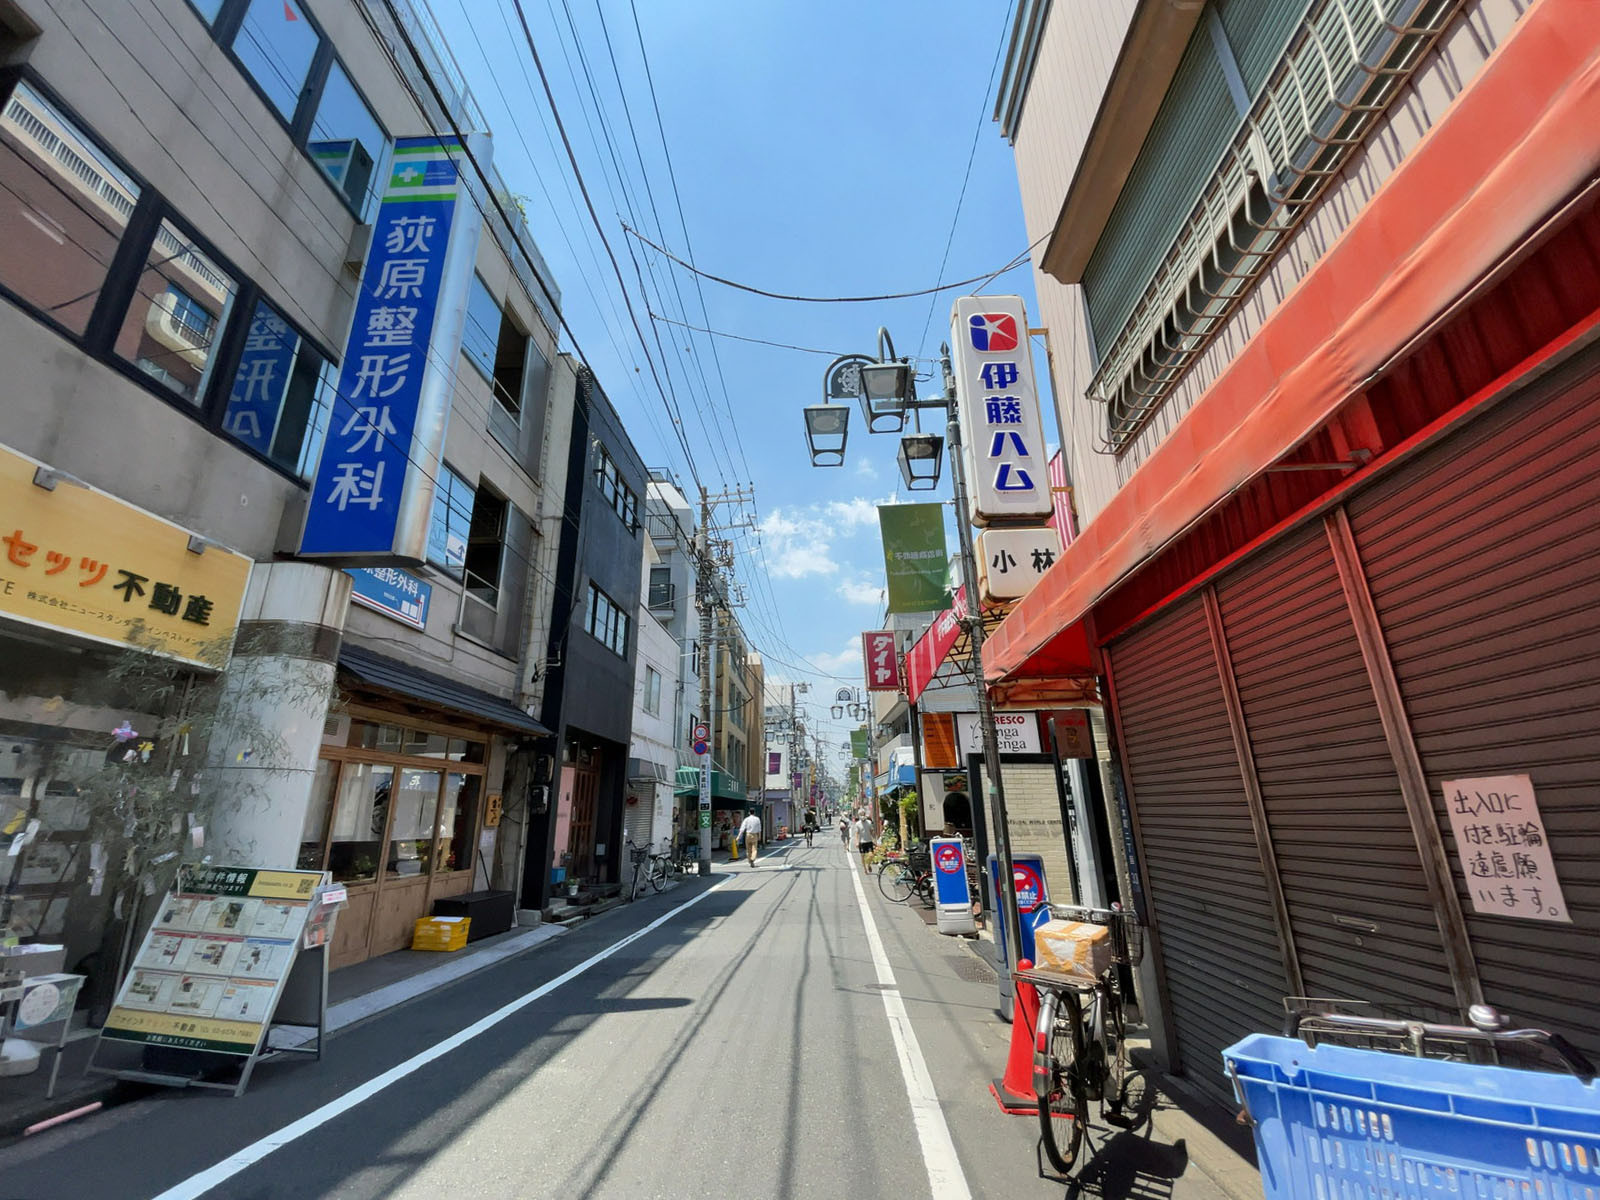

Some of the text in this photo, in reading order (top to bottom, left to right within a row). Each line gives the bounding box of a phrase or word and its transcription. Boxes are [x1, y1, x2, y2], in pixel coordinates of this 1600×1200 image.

[327, 216, 434, 511] 荻原整形外科
[978, 361, 1035, 492] 伊藤ハム
[992, 548, 1055, 573] 小林
[994, 716, 1025, 724] RESCO
[1454, 789, 1522, 817] 出入口に
[1468, 851, 1541, 880] 遠慮願
[1478, 884, 1559, 917] います。
